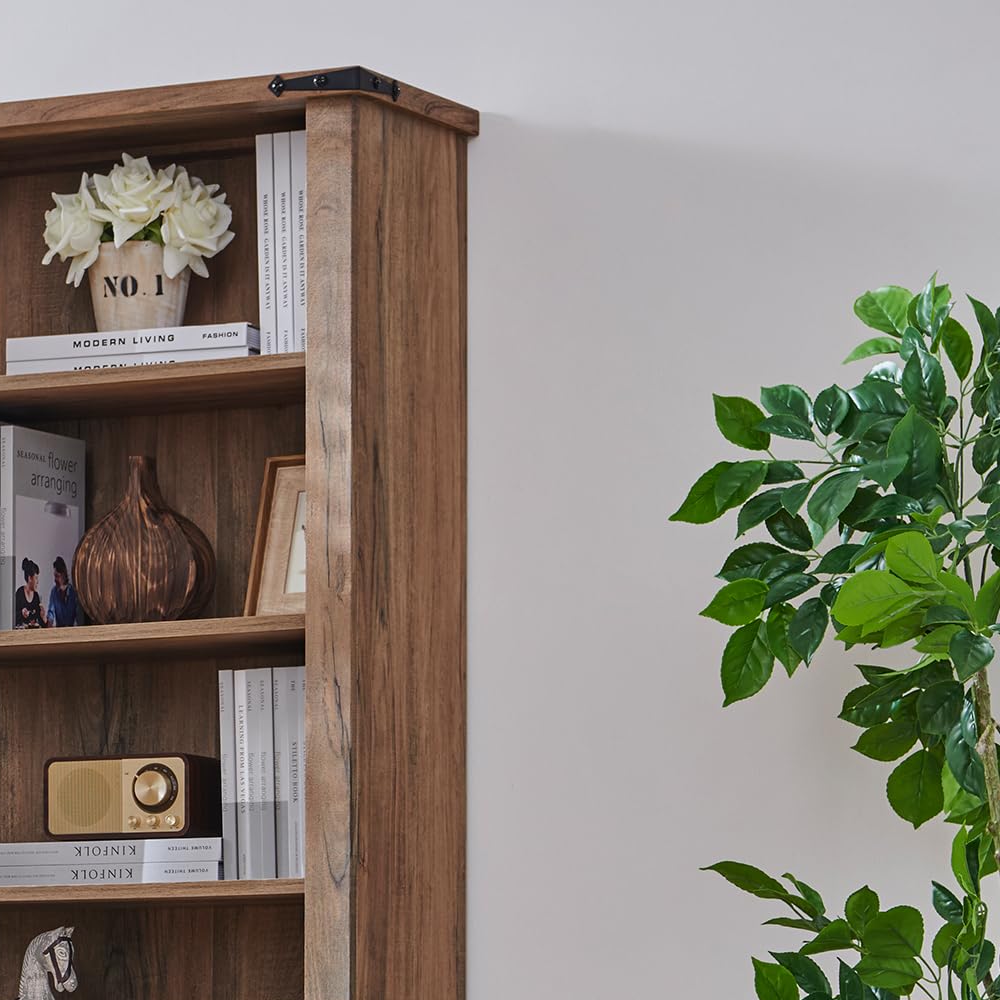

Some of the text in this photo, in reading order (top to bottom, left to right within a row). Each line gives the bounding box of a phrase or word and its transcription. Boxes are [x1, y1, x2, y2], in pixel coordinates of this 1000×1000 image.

[155, 274, 164, 296] 1
[72, 334, 175, 349] MODERN LIVING
[202, 331, 239, 339] FASHION
[16, 449, 78, 472] SEASONAL flower
[31, 473, 78, 498] arranging
[74, 845, 136, 857] KINFOLK
[71, 868, 133, 880] KINFOLK
